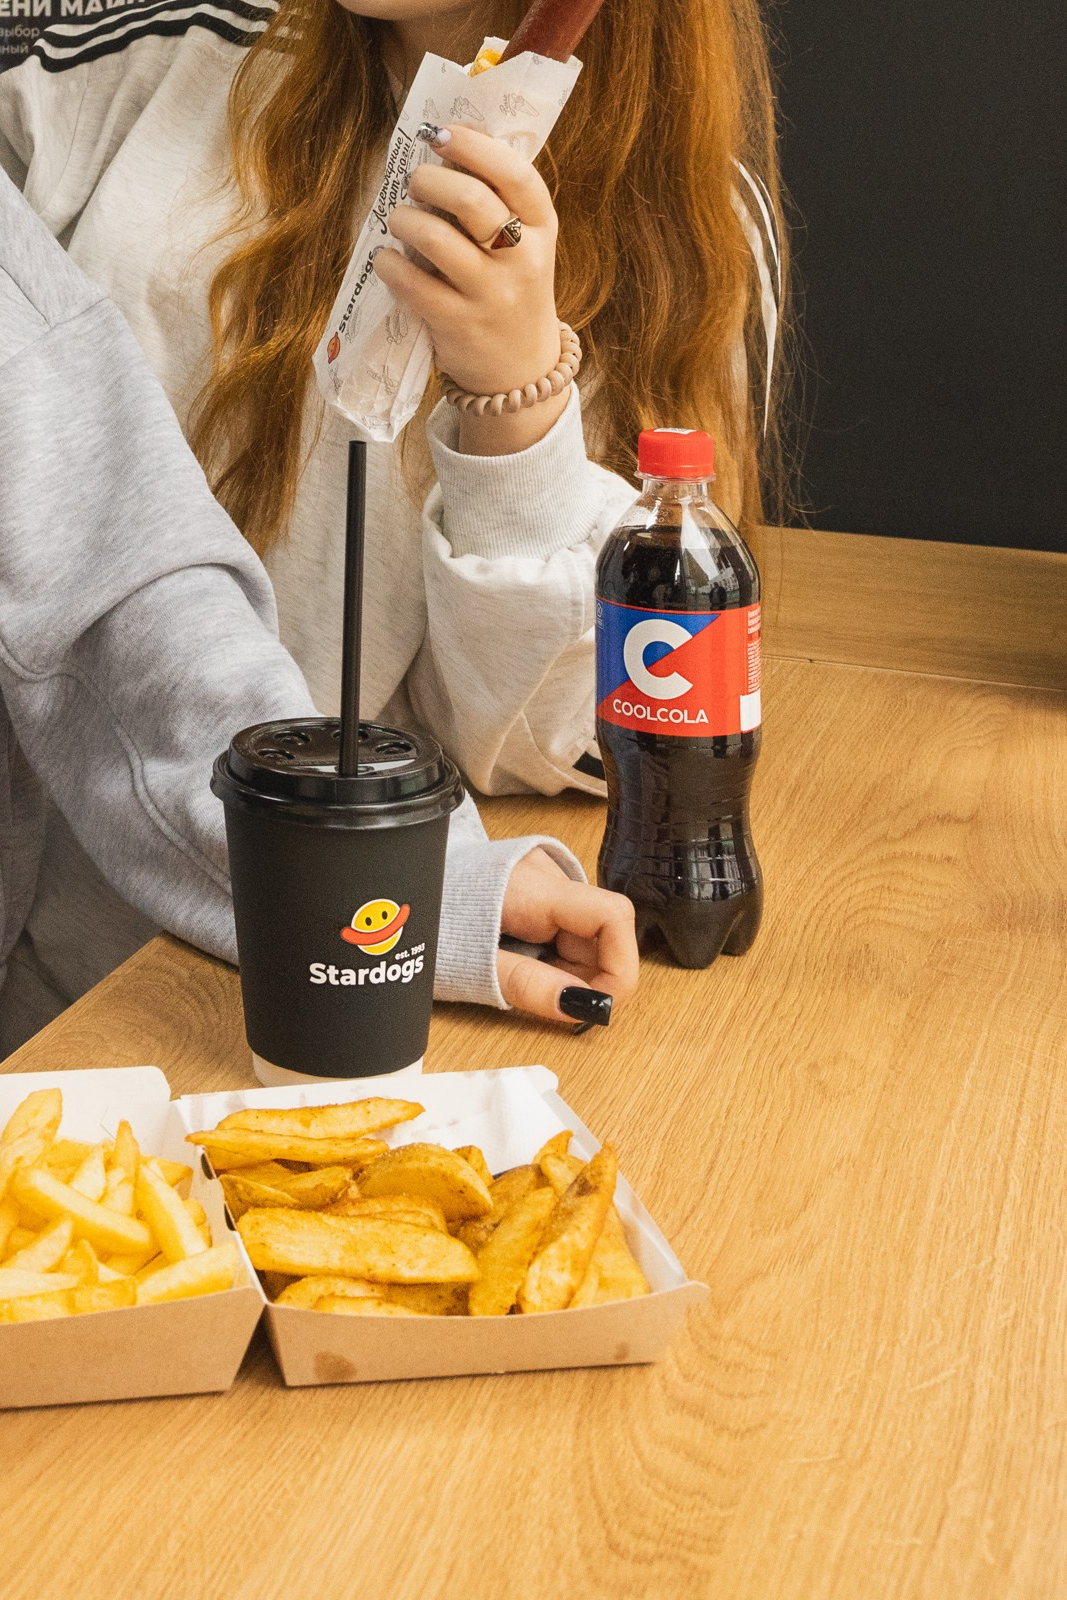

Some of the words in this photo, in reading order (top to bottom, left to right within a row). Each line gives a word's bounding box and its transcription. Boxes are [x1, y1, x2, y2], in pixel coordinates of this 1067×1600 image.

[623, 618, 694, 700] C
[612, 698, 709, 725] COOLCOLA
[394, 949, 410, 961] est.
[411, 942, 426, 956] 1993
[309, 954, 425, 986] Stardogs
